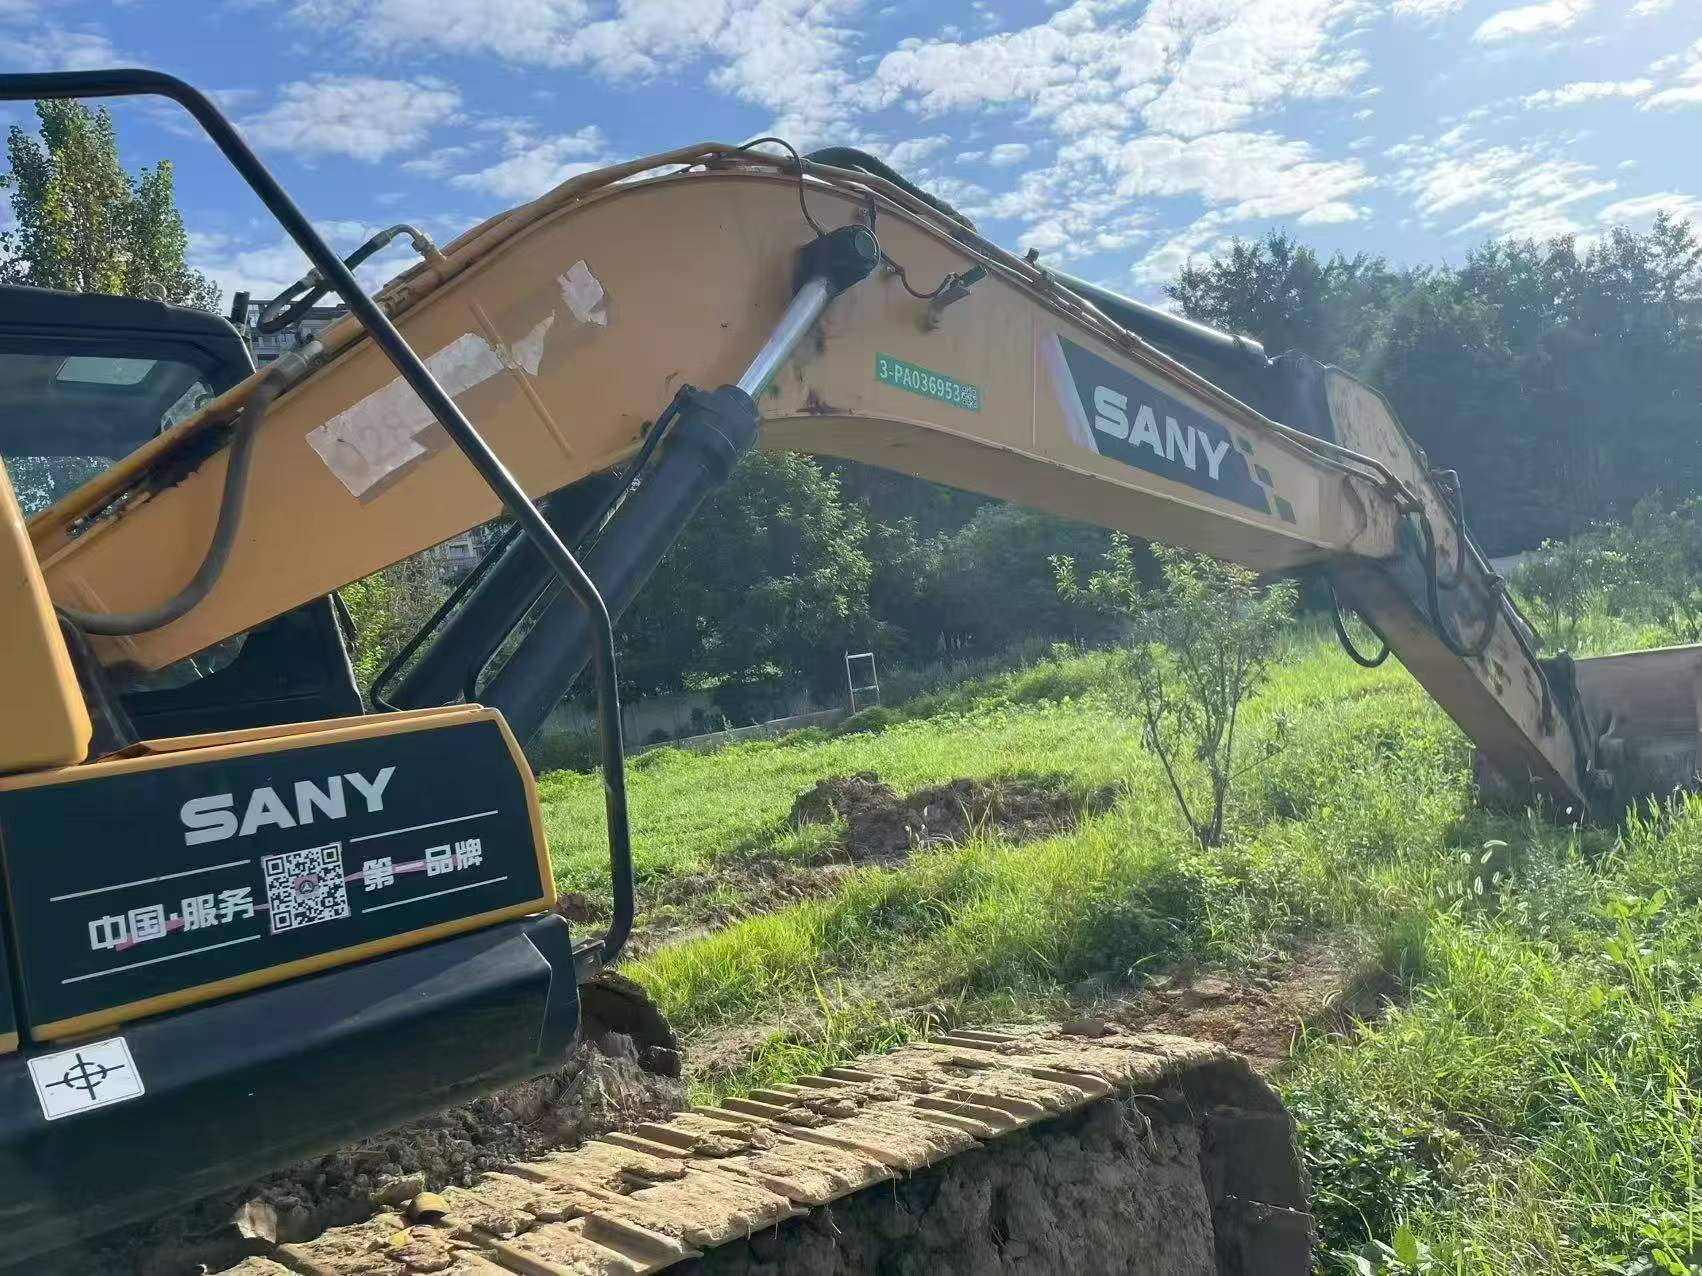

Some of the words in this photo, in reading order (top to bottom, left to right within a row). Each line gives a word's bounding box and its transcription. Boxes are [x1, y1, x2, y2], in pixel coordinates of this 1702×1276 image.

[880, 359, 960, 402] 3-PA036953
[1093, 385, 1230, 481] SANY
[179, 766, 397, 847] SANY
[362, 838, 484, 892] 第一品牌
